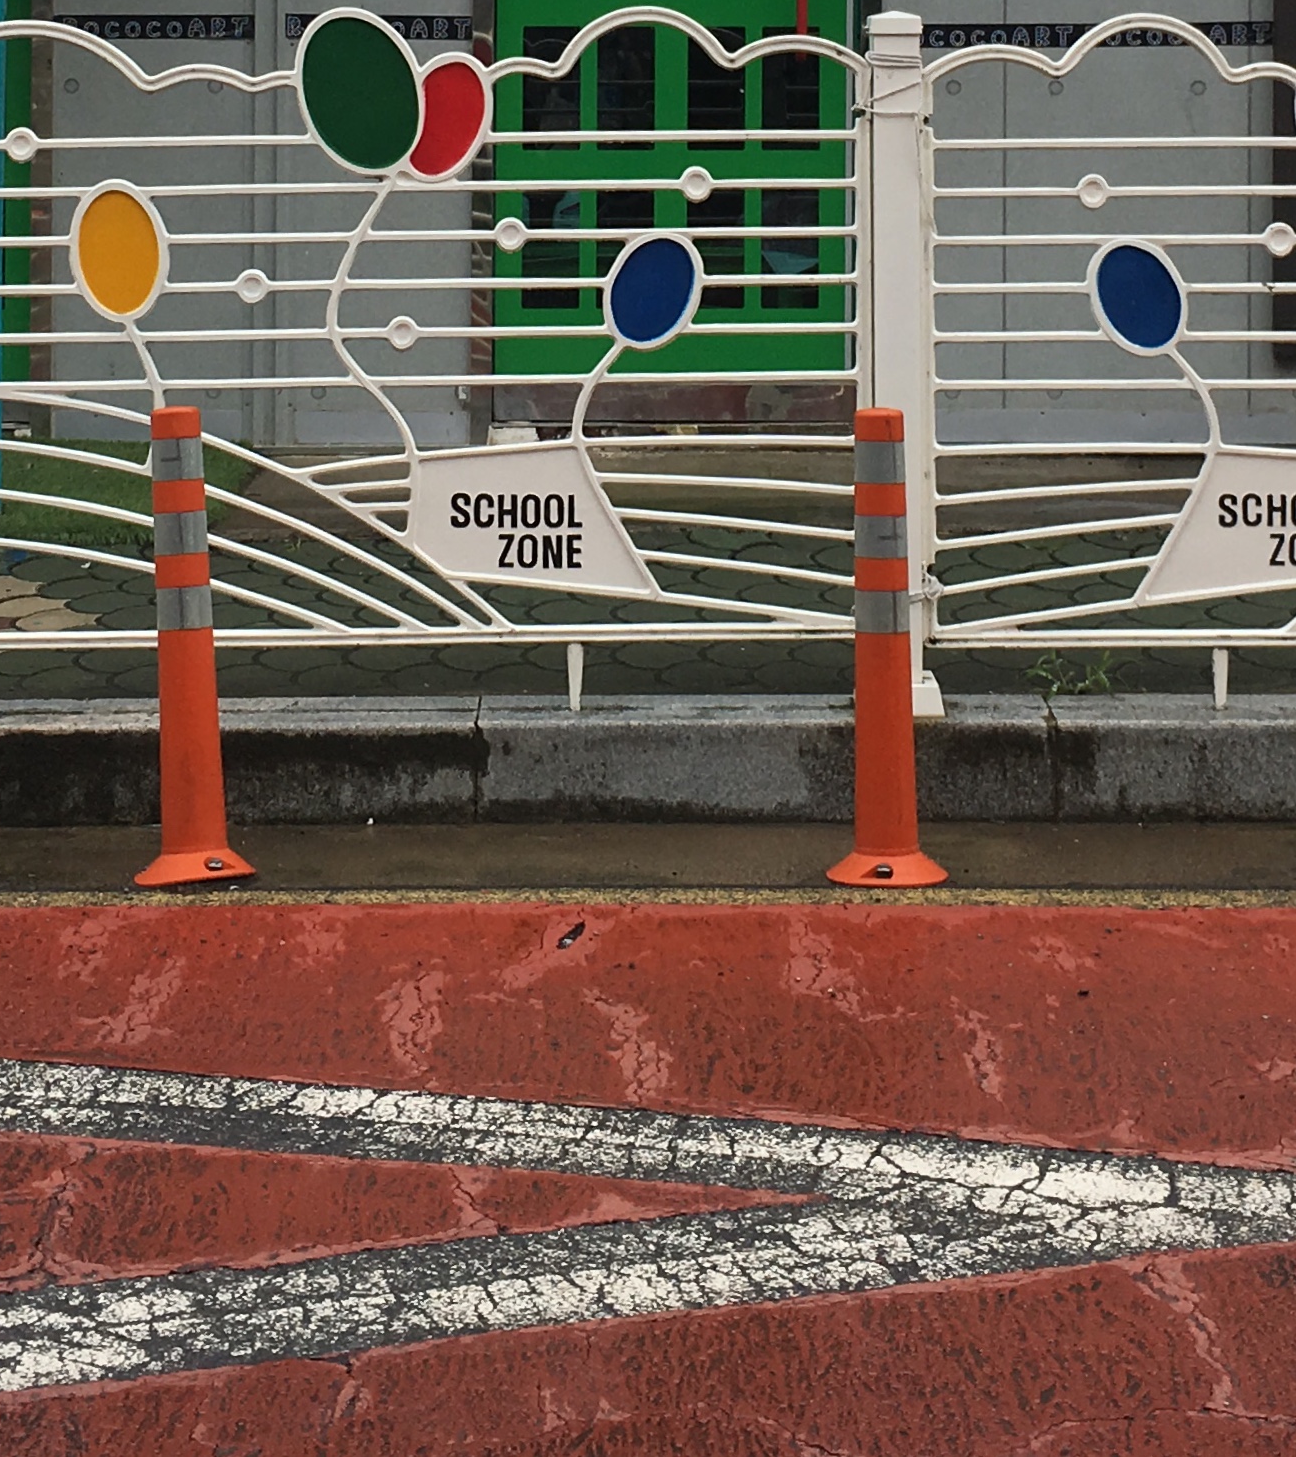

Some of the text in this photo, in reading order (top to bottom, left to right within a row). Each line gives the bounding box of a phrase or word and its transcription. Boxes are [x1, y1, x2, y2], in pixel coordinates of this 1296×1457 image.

[920, 26, 1073, 47] COCOART
[450, 492, 583, 529] SCHOOL
[498, 533, 583, 570] ZONE
